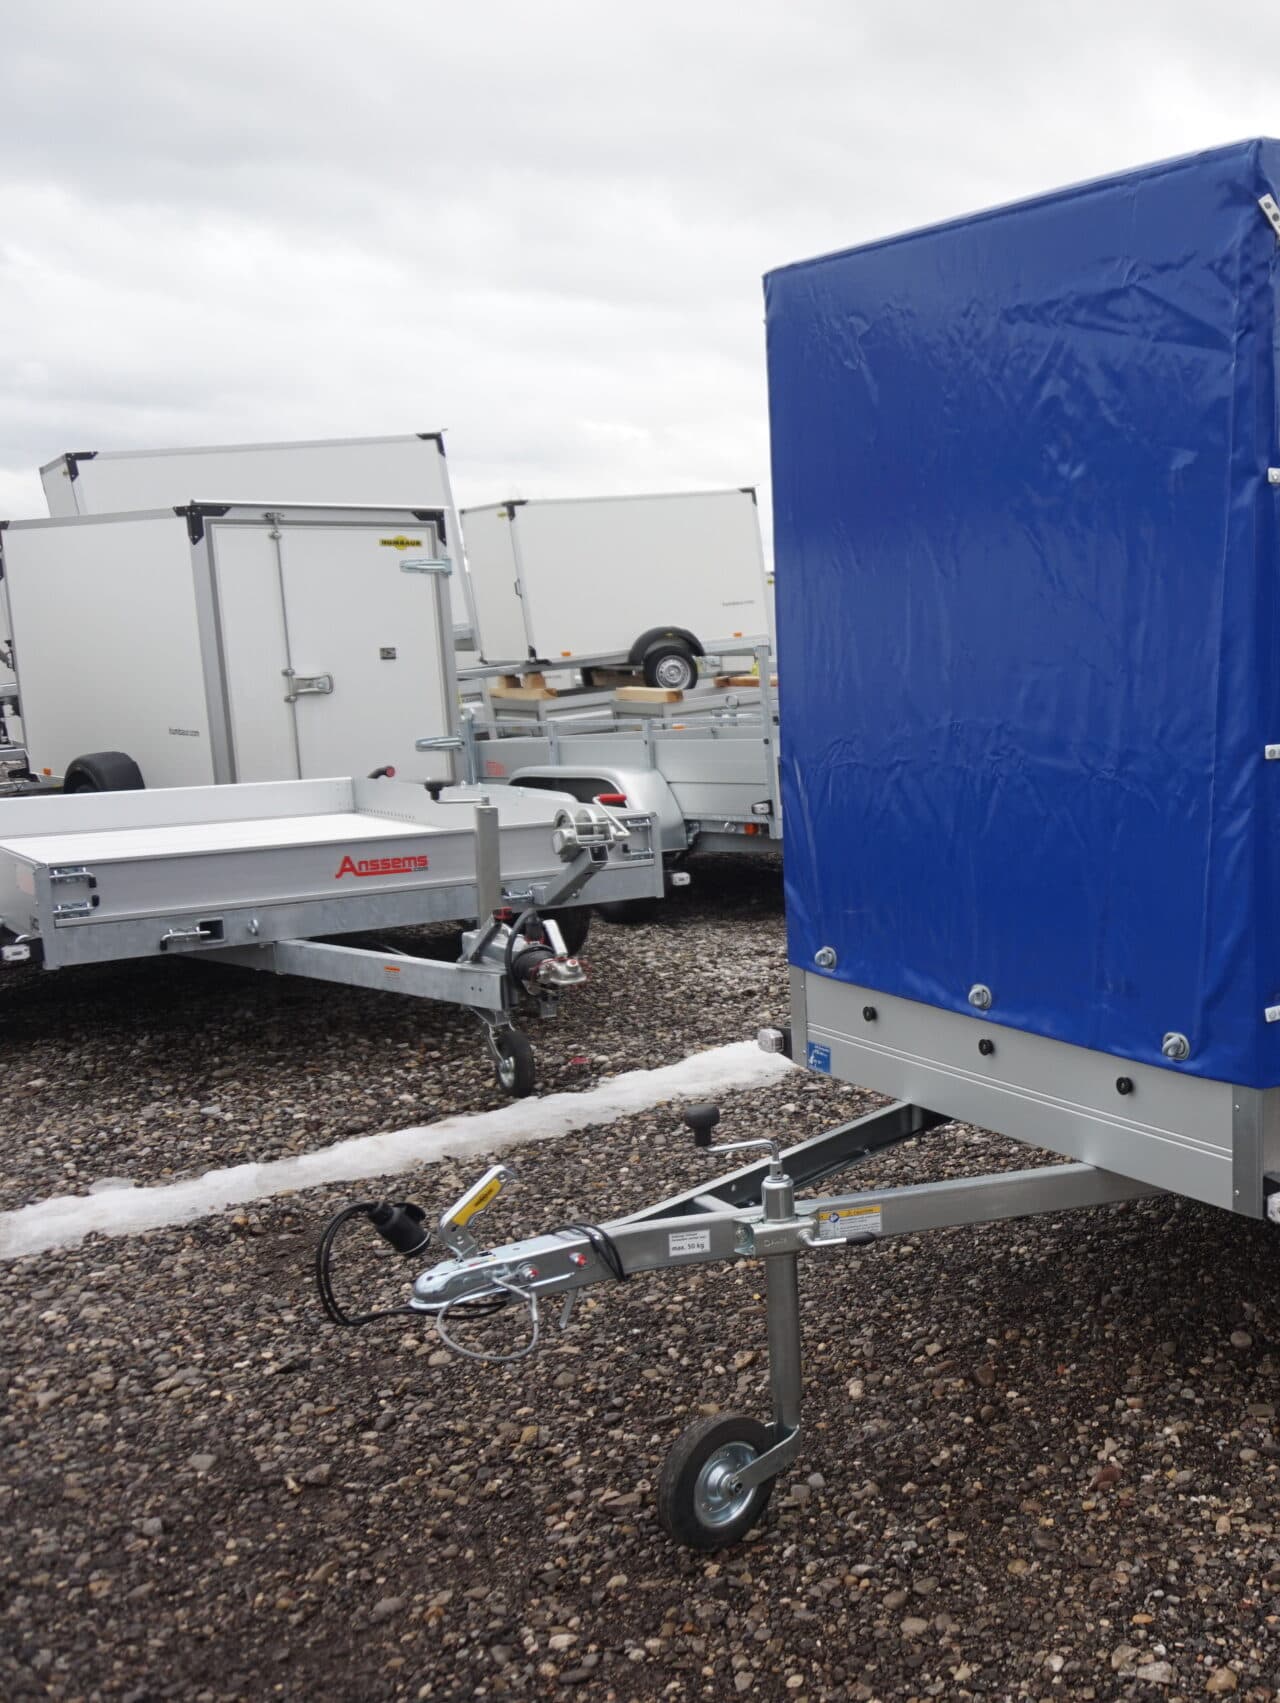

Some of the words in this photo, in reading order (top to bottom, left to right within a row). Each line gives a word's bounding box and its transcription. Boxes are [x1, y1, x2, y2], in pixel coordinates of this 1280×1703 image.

[335, 855, 429, 879] Anssems
[687, 1242, 696, 1250] 50
[696, 1242, 705, 1251] kg
